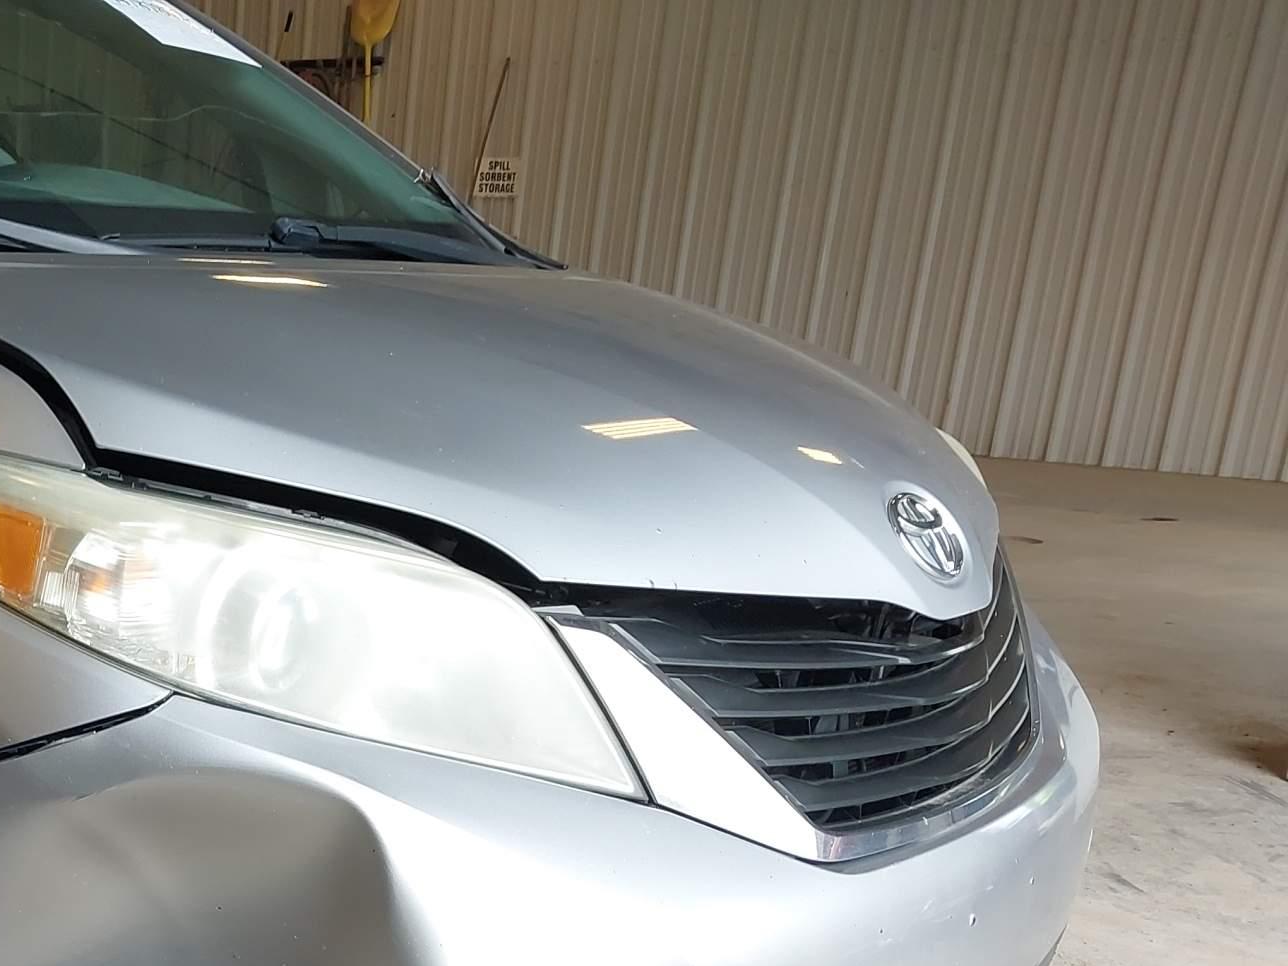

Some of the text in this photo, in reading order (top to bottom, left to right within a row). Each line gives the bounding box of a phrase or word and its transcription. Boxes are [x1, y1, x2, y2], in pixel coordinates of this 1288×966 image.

[488, 160, 511, 171] SPILL
[479, 171, 517, 182] SORBENT
[478, 182, 515, 193] STORAGE
